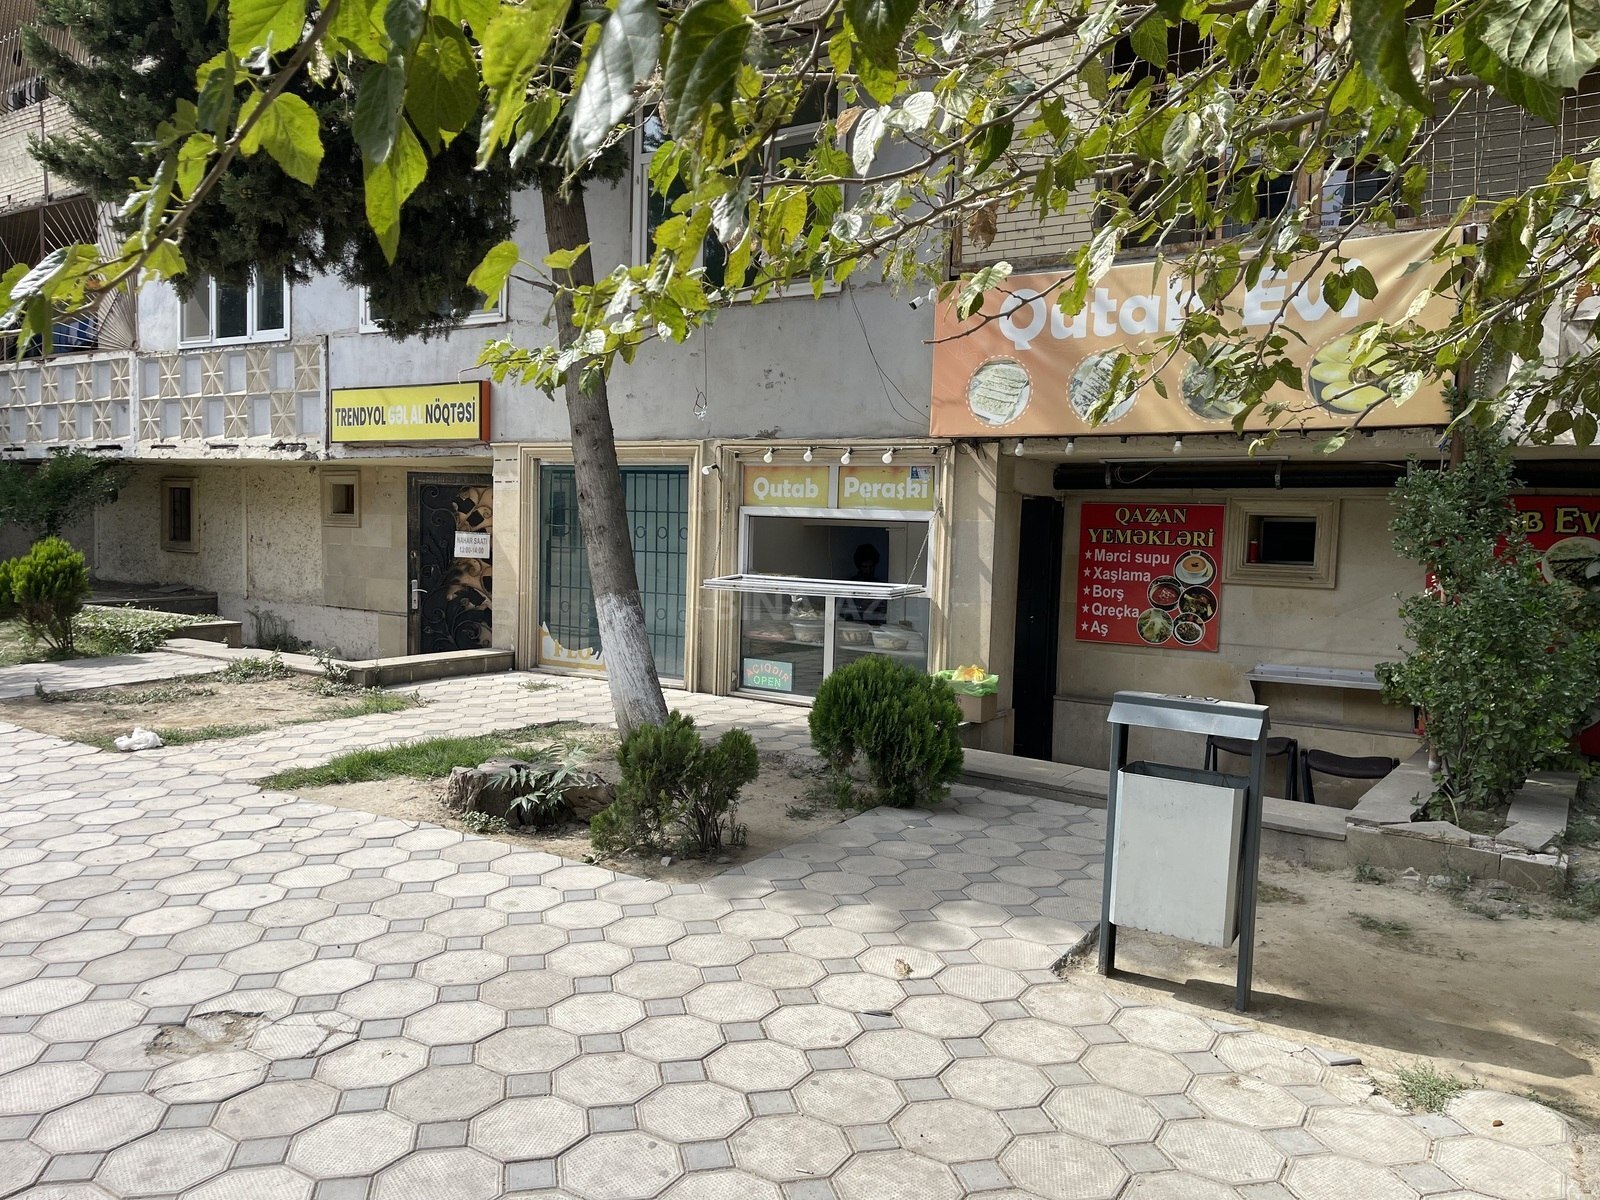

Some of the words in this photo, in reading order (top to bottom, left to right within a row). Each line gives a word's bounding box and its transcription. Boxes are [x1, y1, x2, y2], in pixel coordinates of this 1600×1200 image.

[335, 405, 387, 427] TRENDYOL
[388, 404, 409, 425] GƏL
[410, 403, 424, 424] AL
[425, 396, 476, 427] NÖQTƏSİ
[753, 476, 819, 500] Qutab
[844, 476, 928, 499] Peraşki
[1115, 507, 1188, 525] QAZAN
[1088, 528, 1215, 547] YEMƏKLƏRİ
[1094, 549, 1131, 562] Mərci
[1135, 554, 1170, 567] supu
[1092, 566, 1151, 583] Xaşlama
[1092, 584, 1124, 601] Borş
[1091, 603, 1140, 619] Qreçka
[1090, 621, 1109, 637] Aş
[753, 675, 781, 688] OPEN
